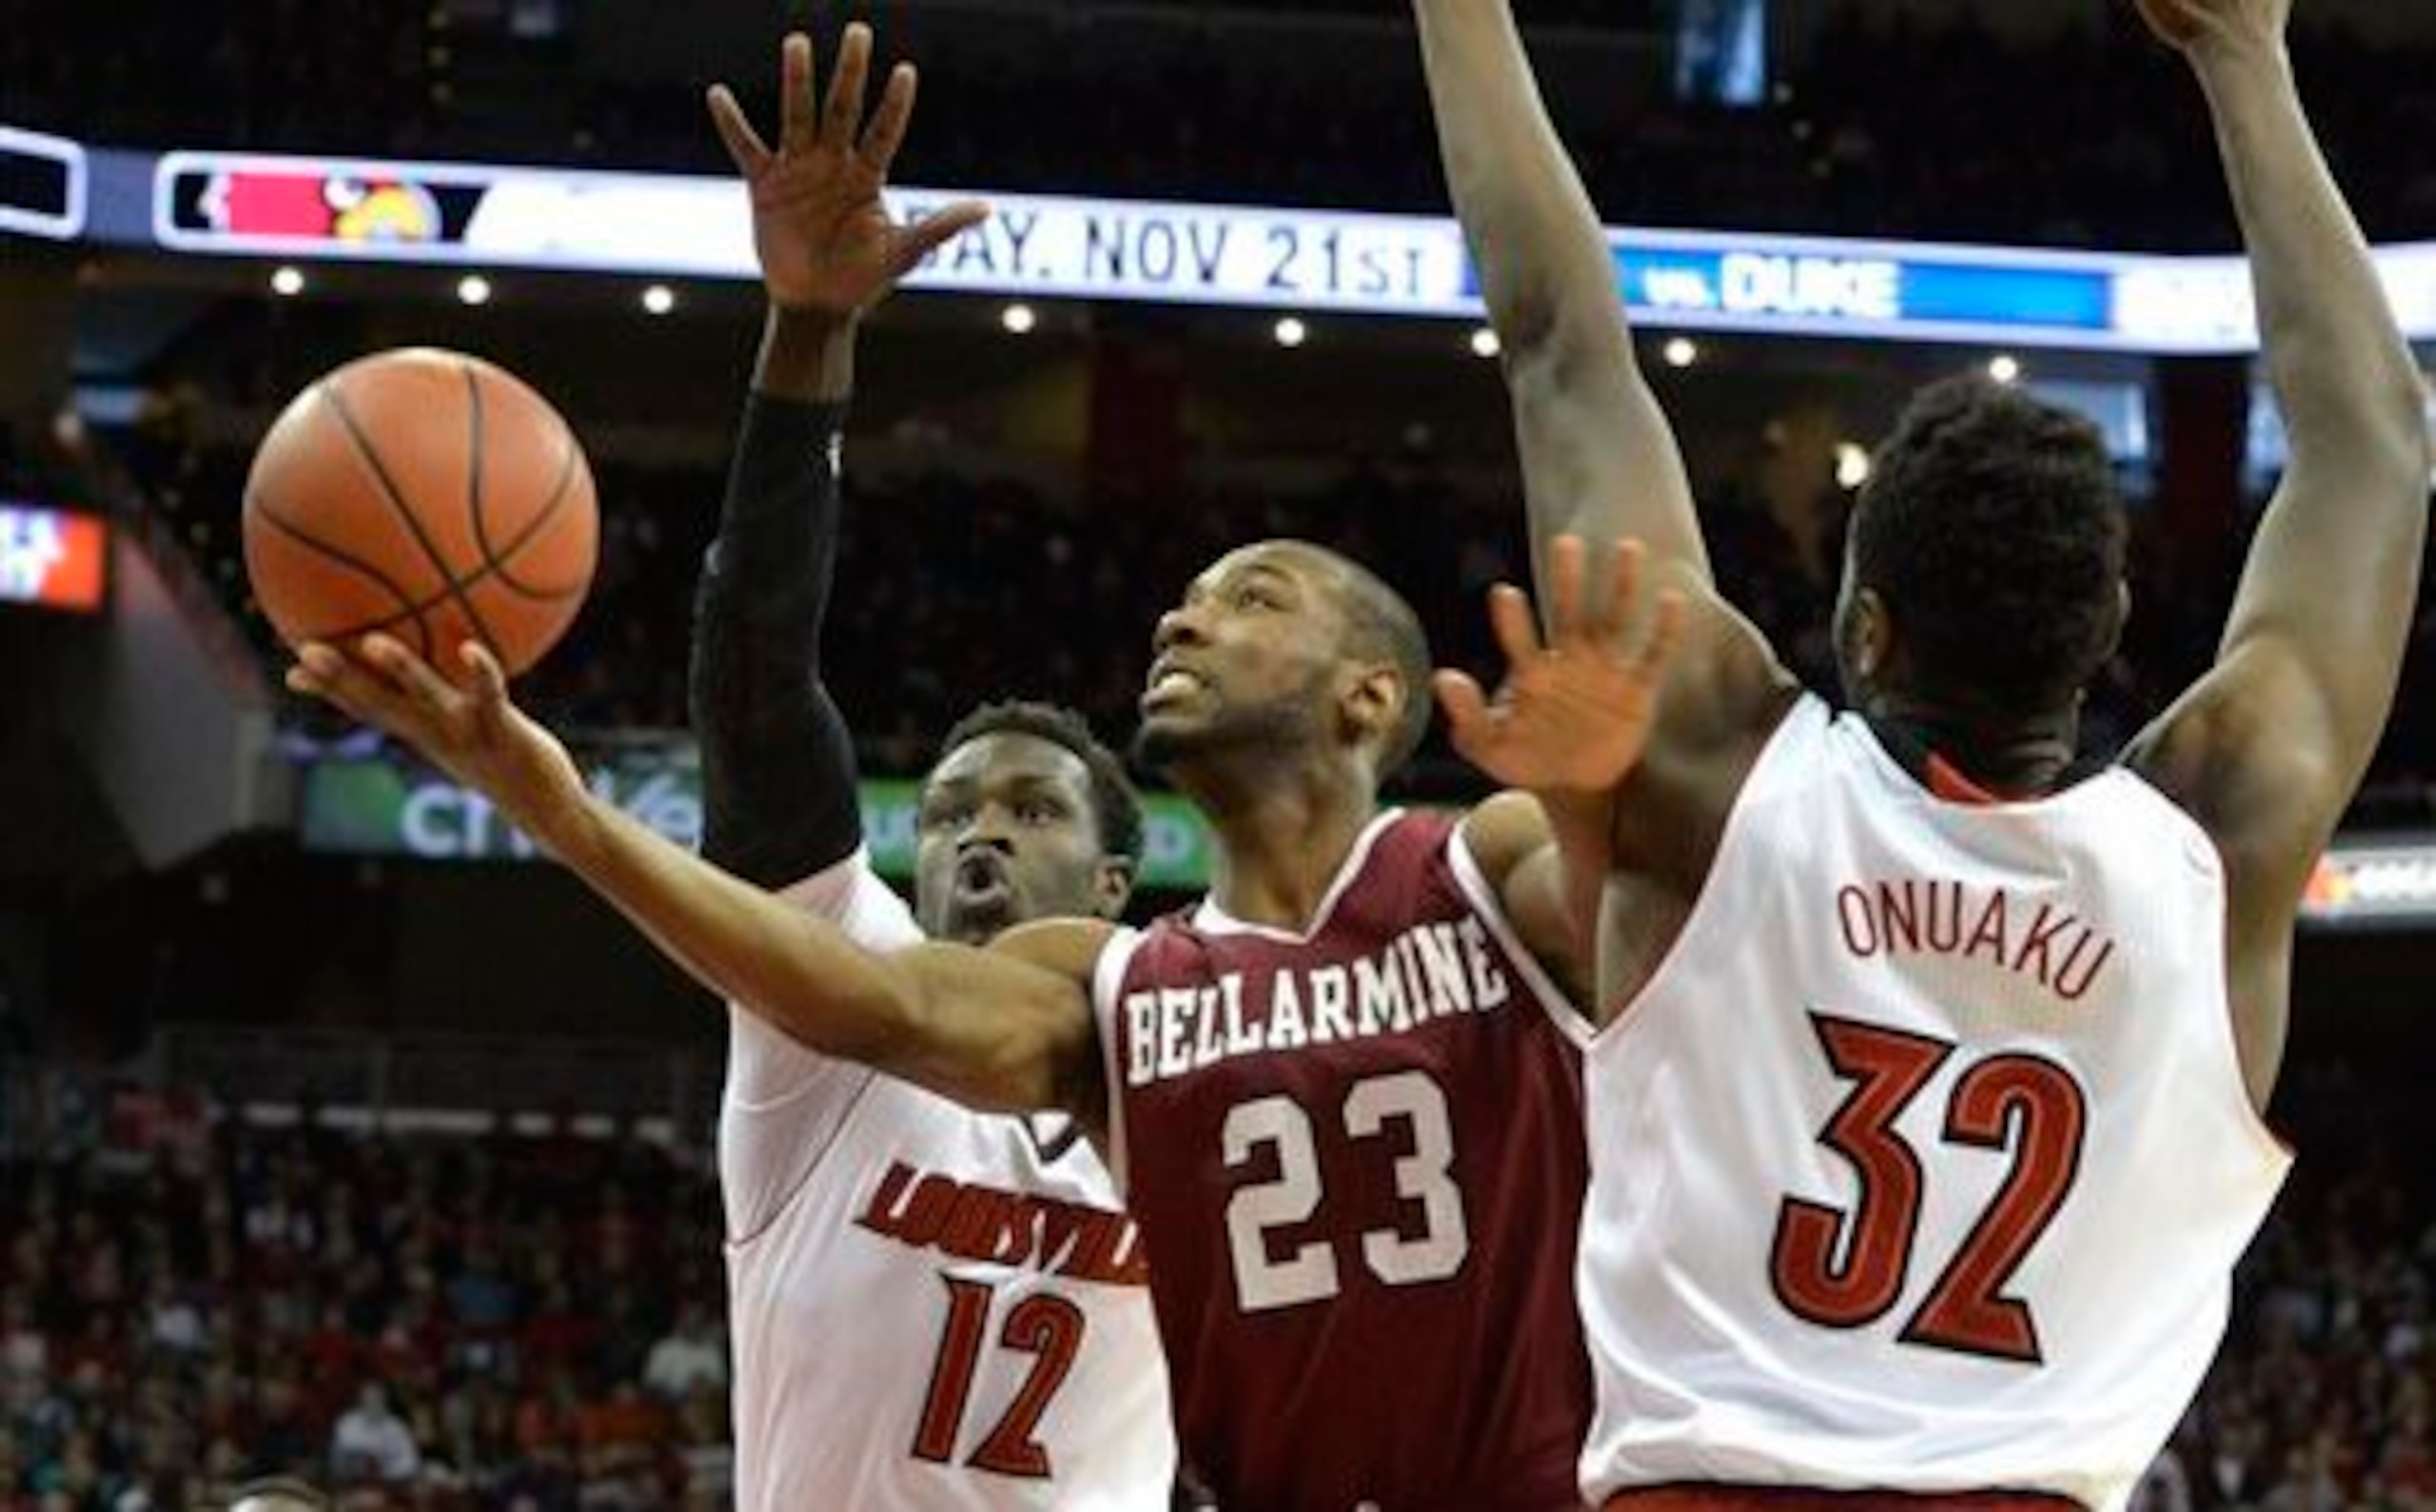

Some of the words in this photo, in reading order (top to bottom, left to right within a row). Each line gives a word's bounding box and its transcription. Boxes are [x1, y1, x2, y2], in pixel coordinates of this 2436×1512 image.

[1085, 215, 1227, 284] NOV
[1721, 251, 1899, 318] DUKE
[1126, 916, 1510, 1088] BELLARMINE
[1837, 880, 2114, 1001] ONUAKU
[1222, 1070, 1470, 1312] 23
[1769, 1010, 2090, 1366] 32
[911, 1269, 1086, 1480] 12
